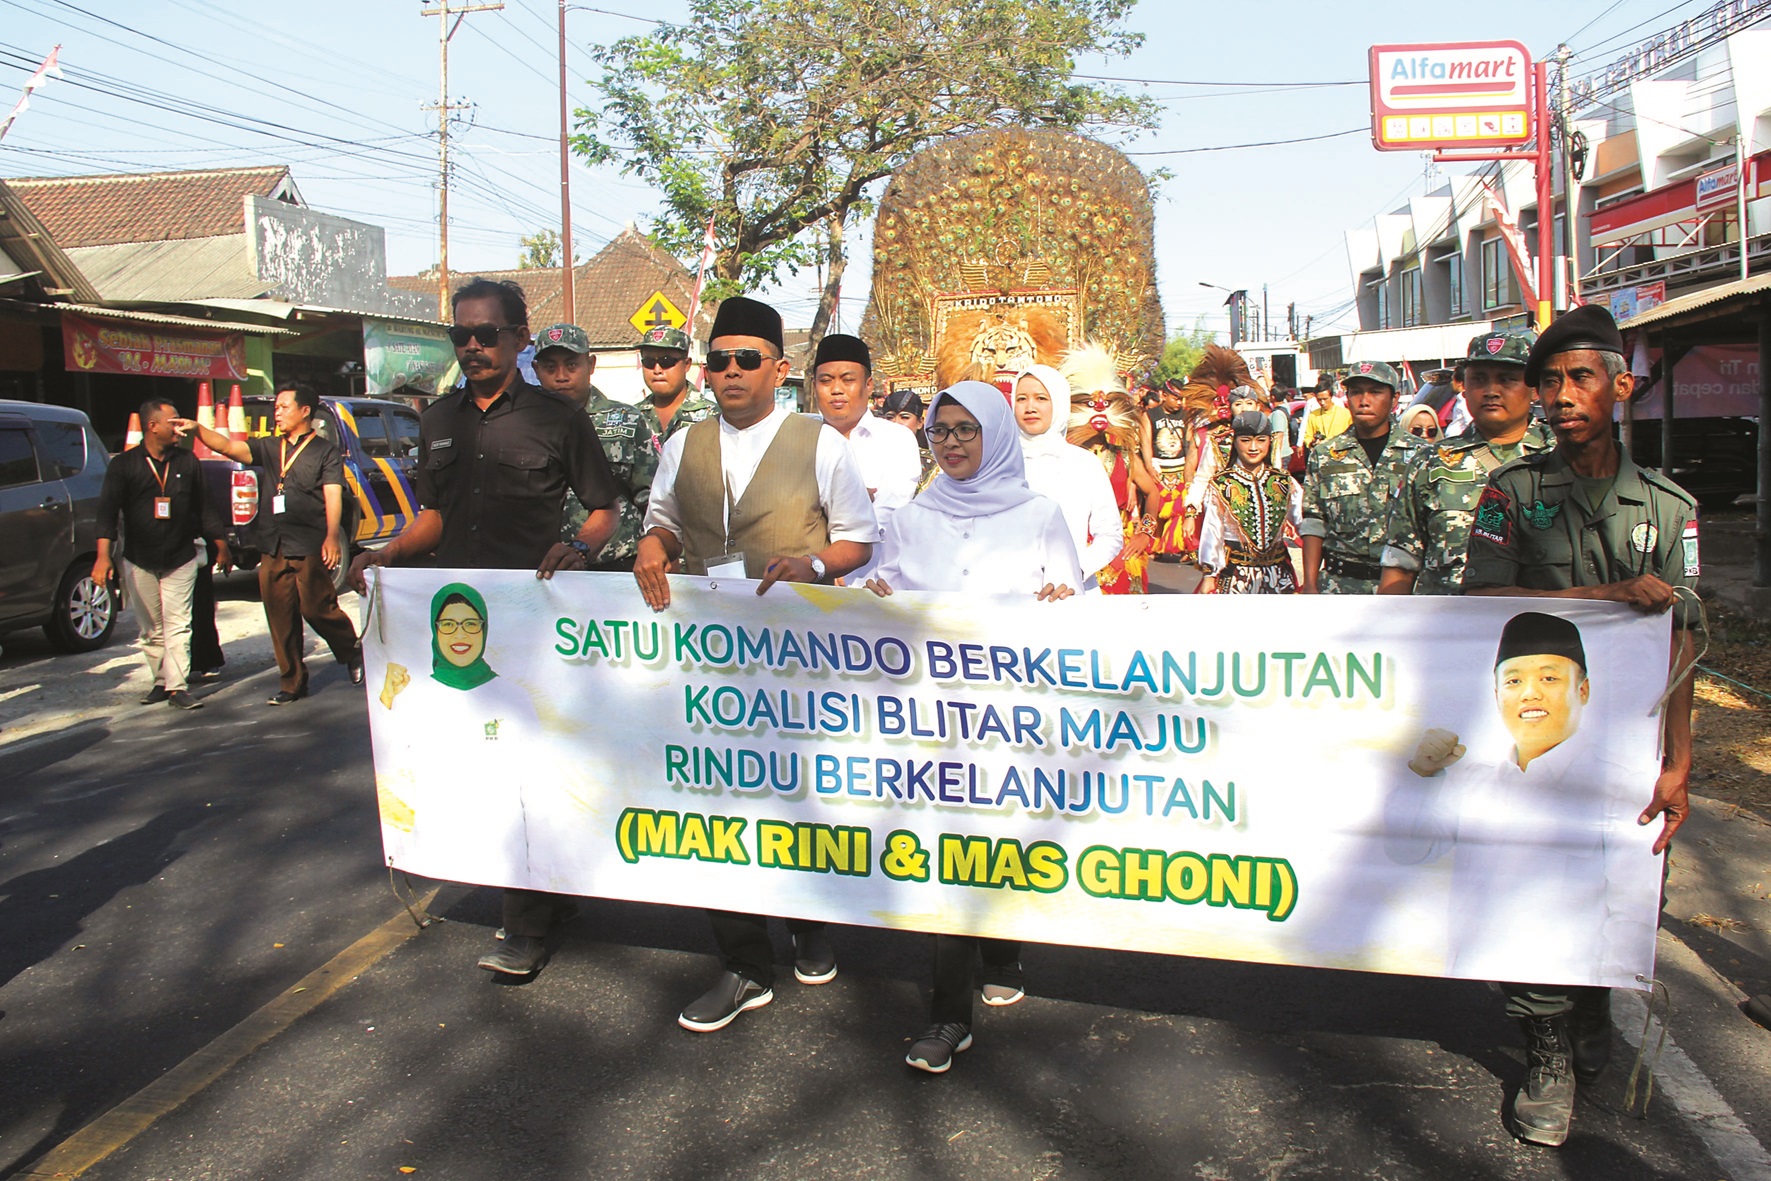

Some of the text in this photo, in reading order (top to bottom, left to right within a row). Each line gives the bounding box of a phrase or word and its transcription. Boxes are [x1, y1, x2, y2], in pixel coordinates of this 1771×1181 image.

[1390, 56, 1516, 80] Alfamart
[1700, 168, 1738, 193] Alfamart
[603, 428, 628, 436] JATIM
[555, 617, 1382, 698] SATU KOMANDO BERKELANJUTAN
[685, 684, 1207, 754] KOALISI BLITAR MAJU
[665, 744, 1235, 822] RINDU BERKELANJUTAN
[616, 807, 1299, 921] (MAK RINI & MAS GHONI)
